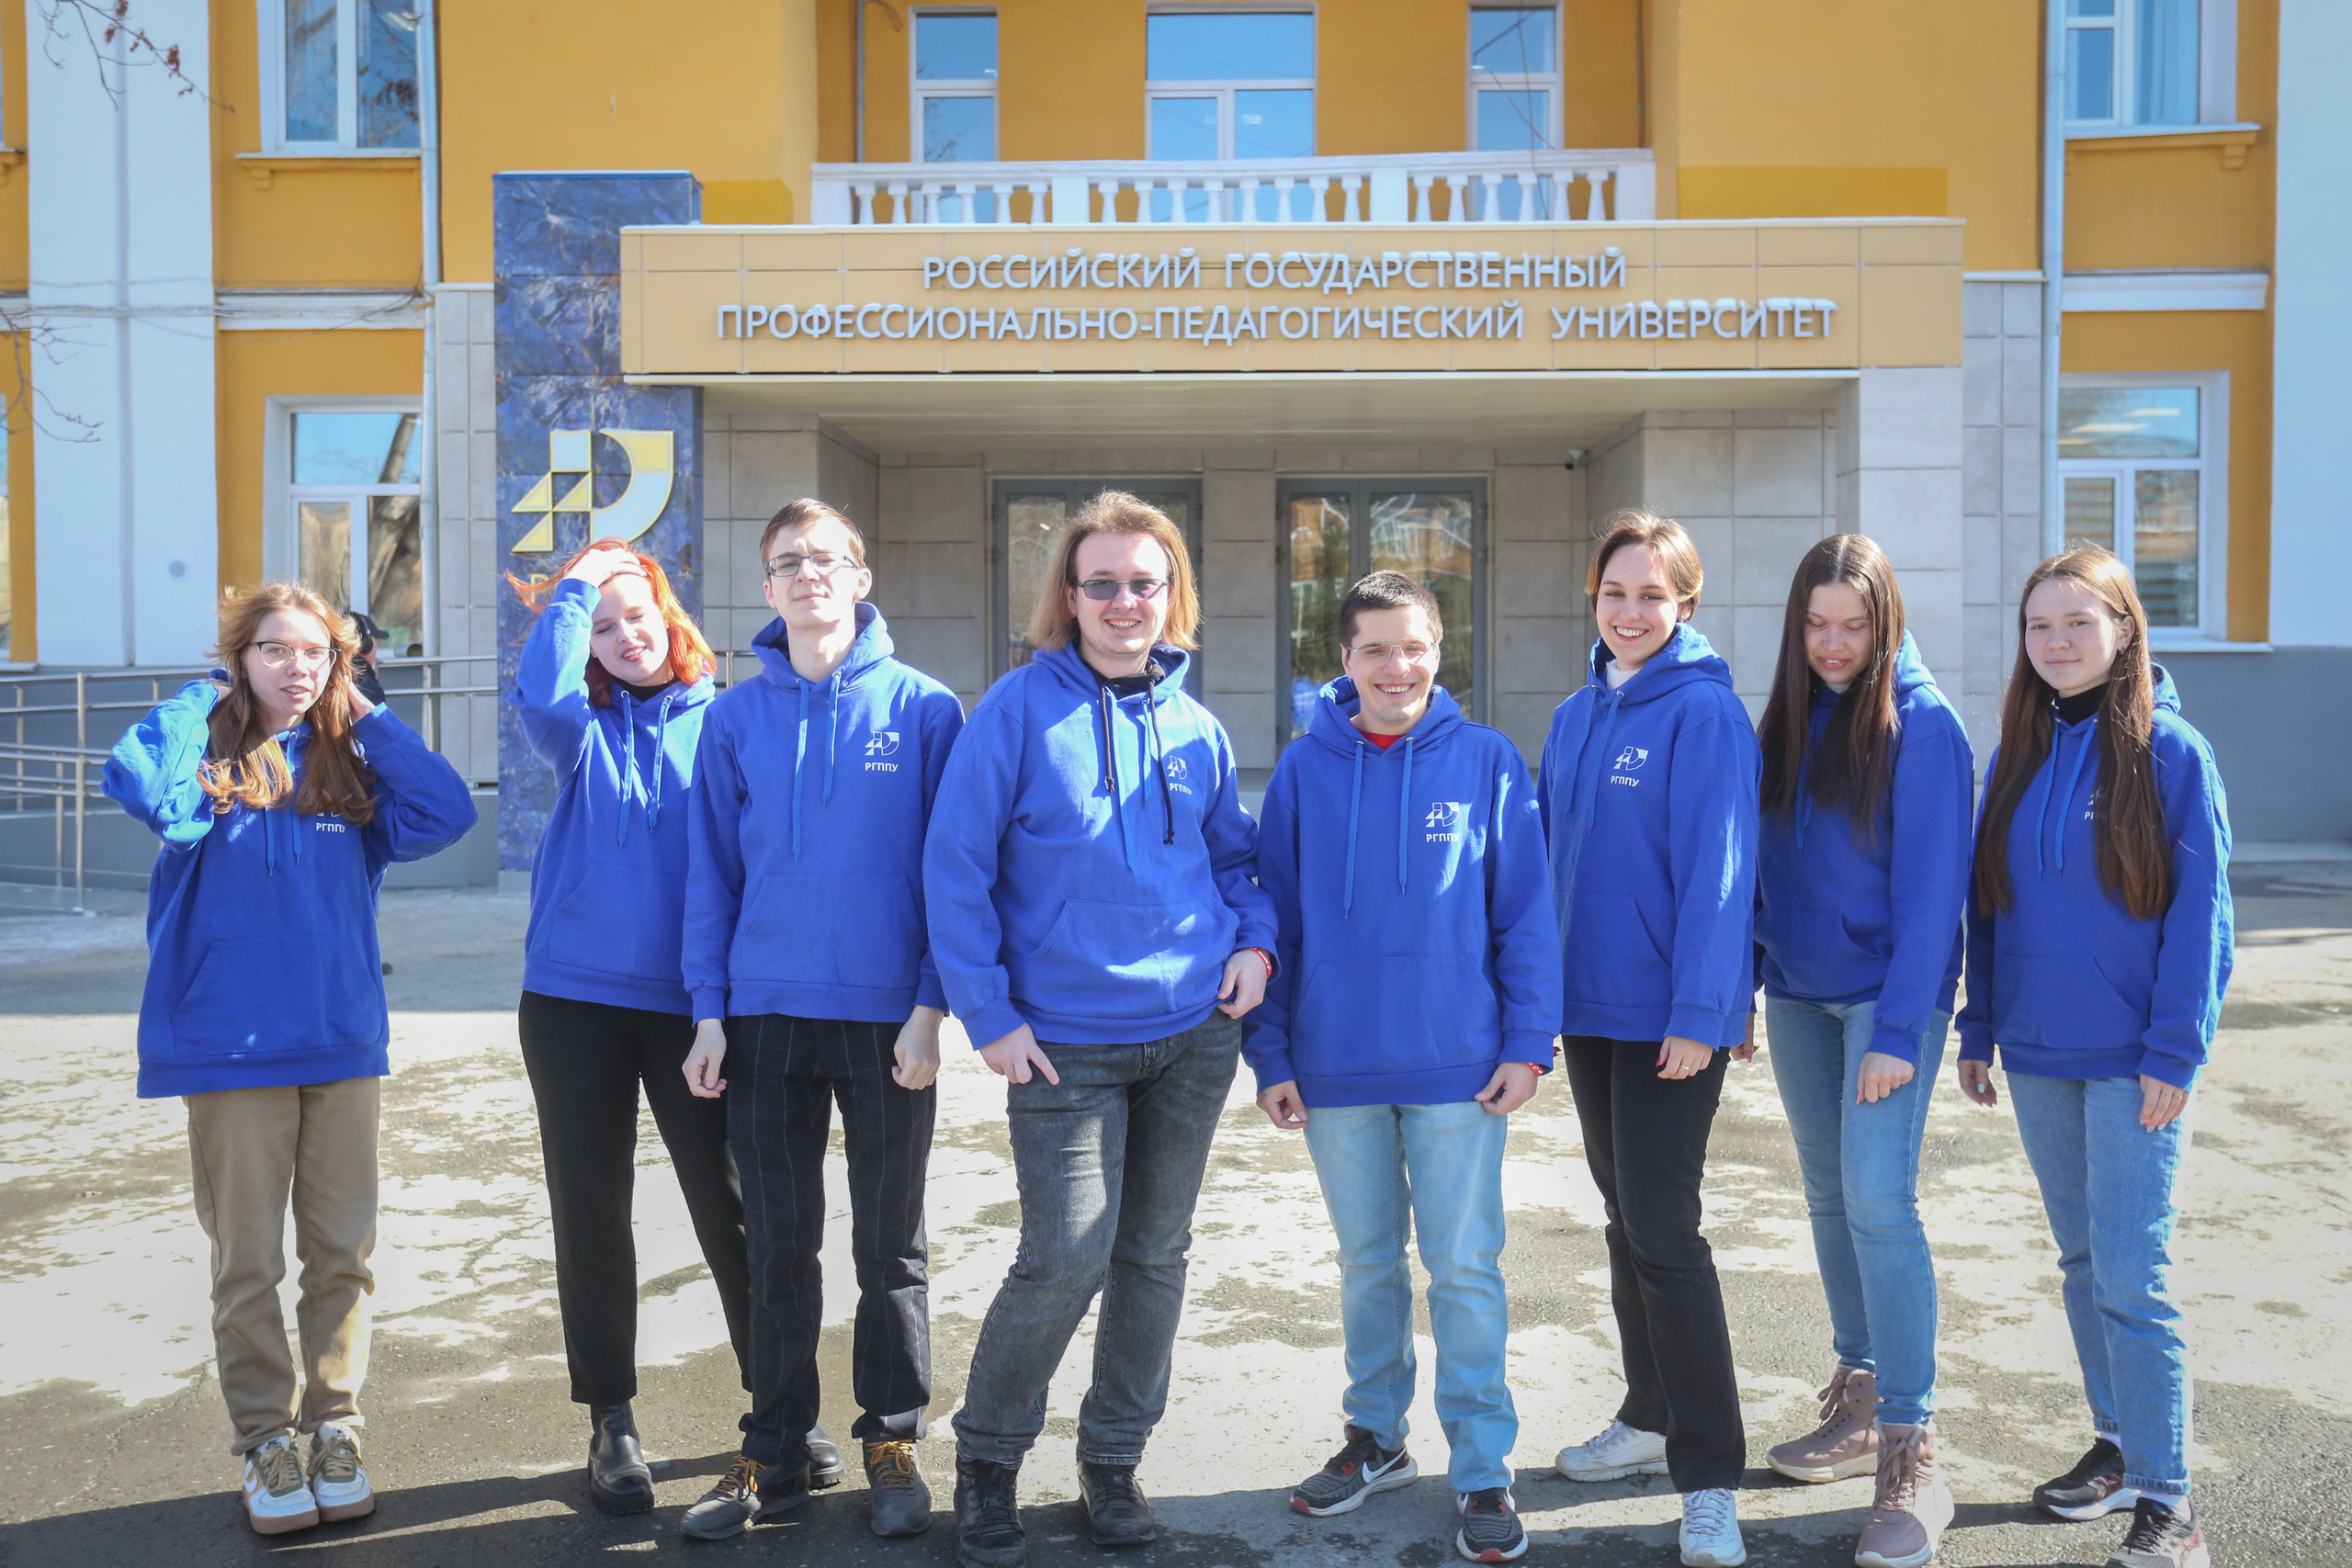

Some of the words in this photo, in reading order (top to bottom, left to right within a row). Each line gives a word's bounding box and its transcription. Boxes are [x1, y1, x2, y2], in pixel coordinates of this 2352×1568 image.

[922, 247, 1202, 289] РОССИЙСКИЙ
[1224, 246, 1627, 295] ГОСУДАРСТВЕННЫЙ
[716, 299, 1525, 346] ПРОФЕССИОНАЛЬНО-ПЕДАГОГИЧЕСКИЙ
[1550, 298, 1838, 341] УНИВЕРСИТЕТ
[865, 761, 899, 772] РГППУ
[1611, 775, 1640, 787] РГППУ
[315, 822, 346, 833] РГППУ
[1426, 832, 1460, 842] РГППУ
